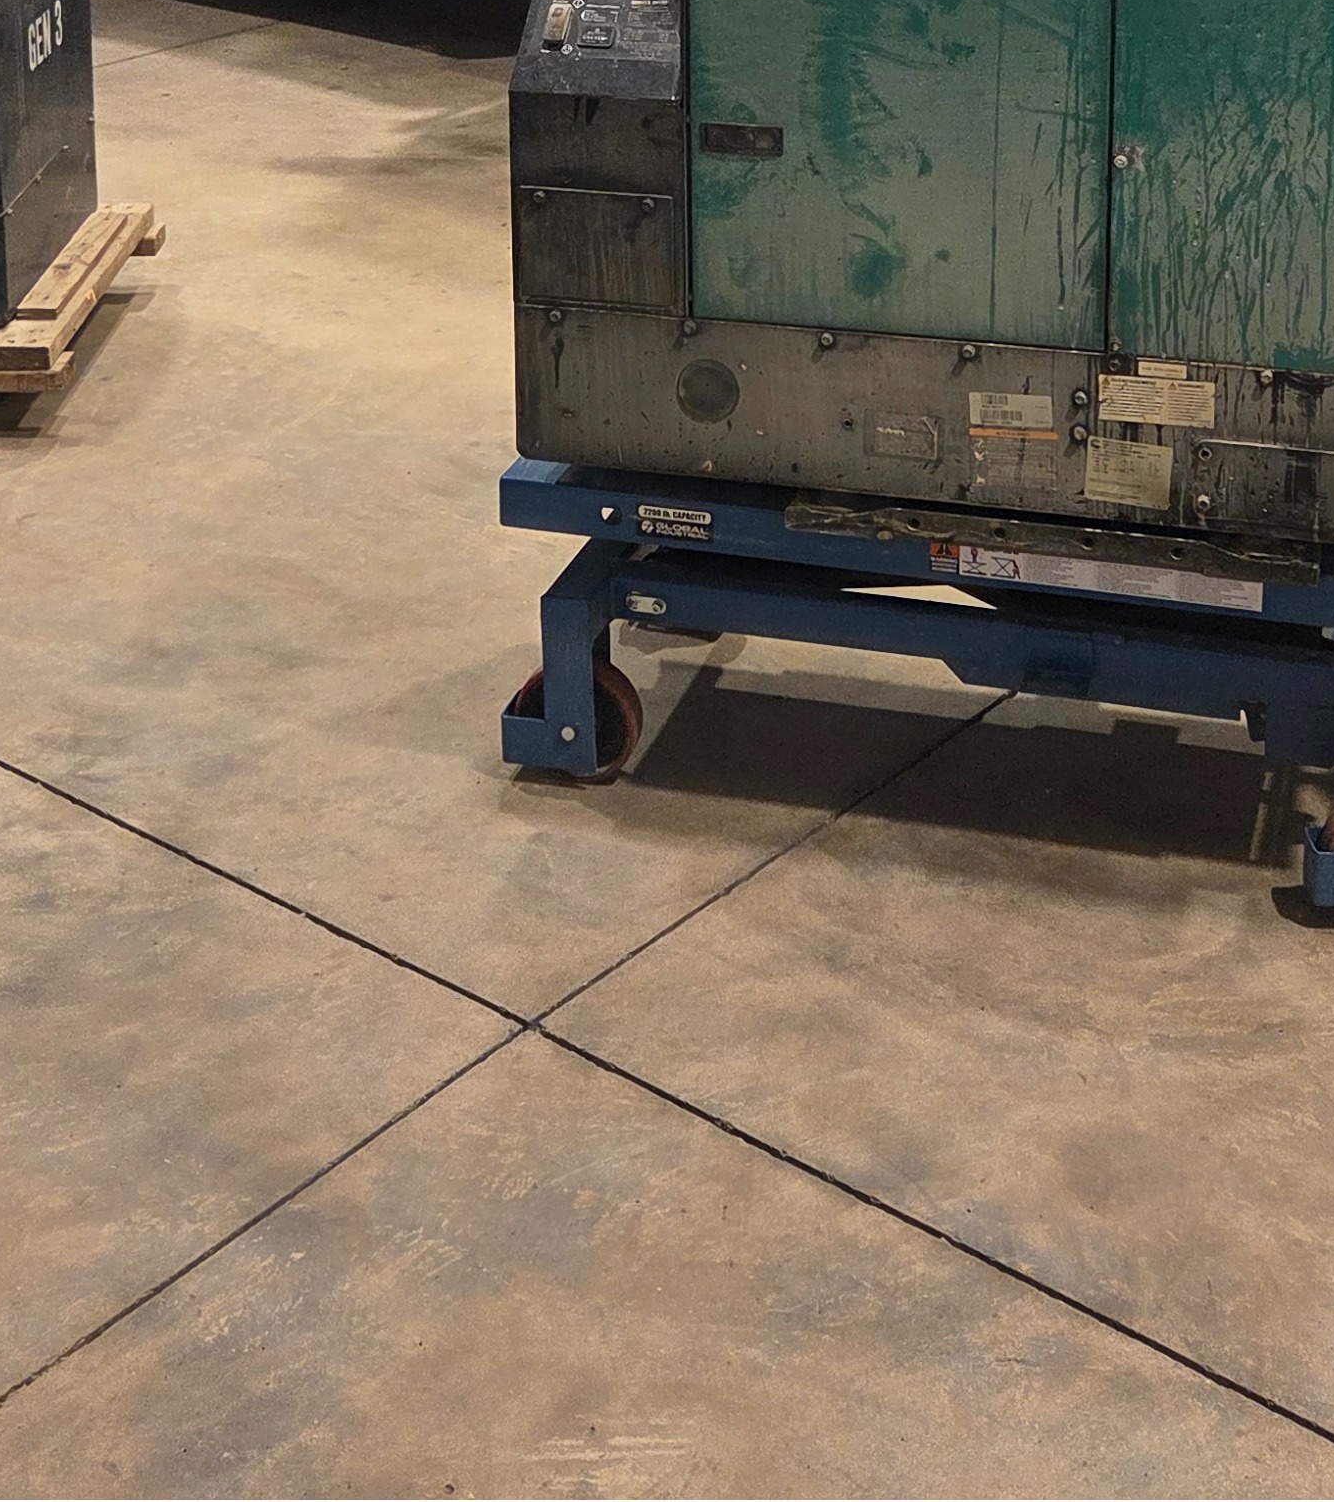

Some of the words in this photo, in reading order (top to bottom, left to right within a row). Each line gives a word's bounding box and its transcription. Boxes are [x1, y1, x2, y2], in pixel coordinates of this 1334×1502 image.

[28, 9, 52, 71] GEN
[54, 0, 63, 46] 3
[672, 511, 706, 522] CAPACITY
[655, 521, 710, 534] GLOBAL
